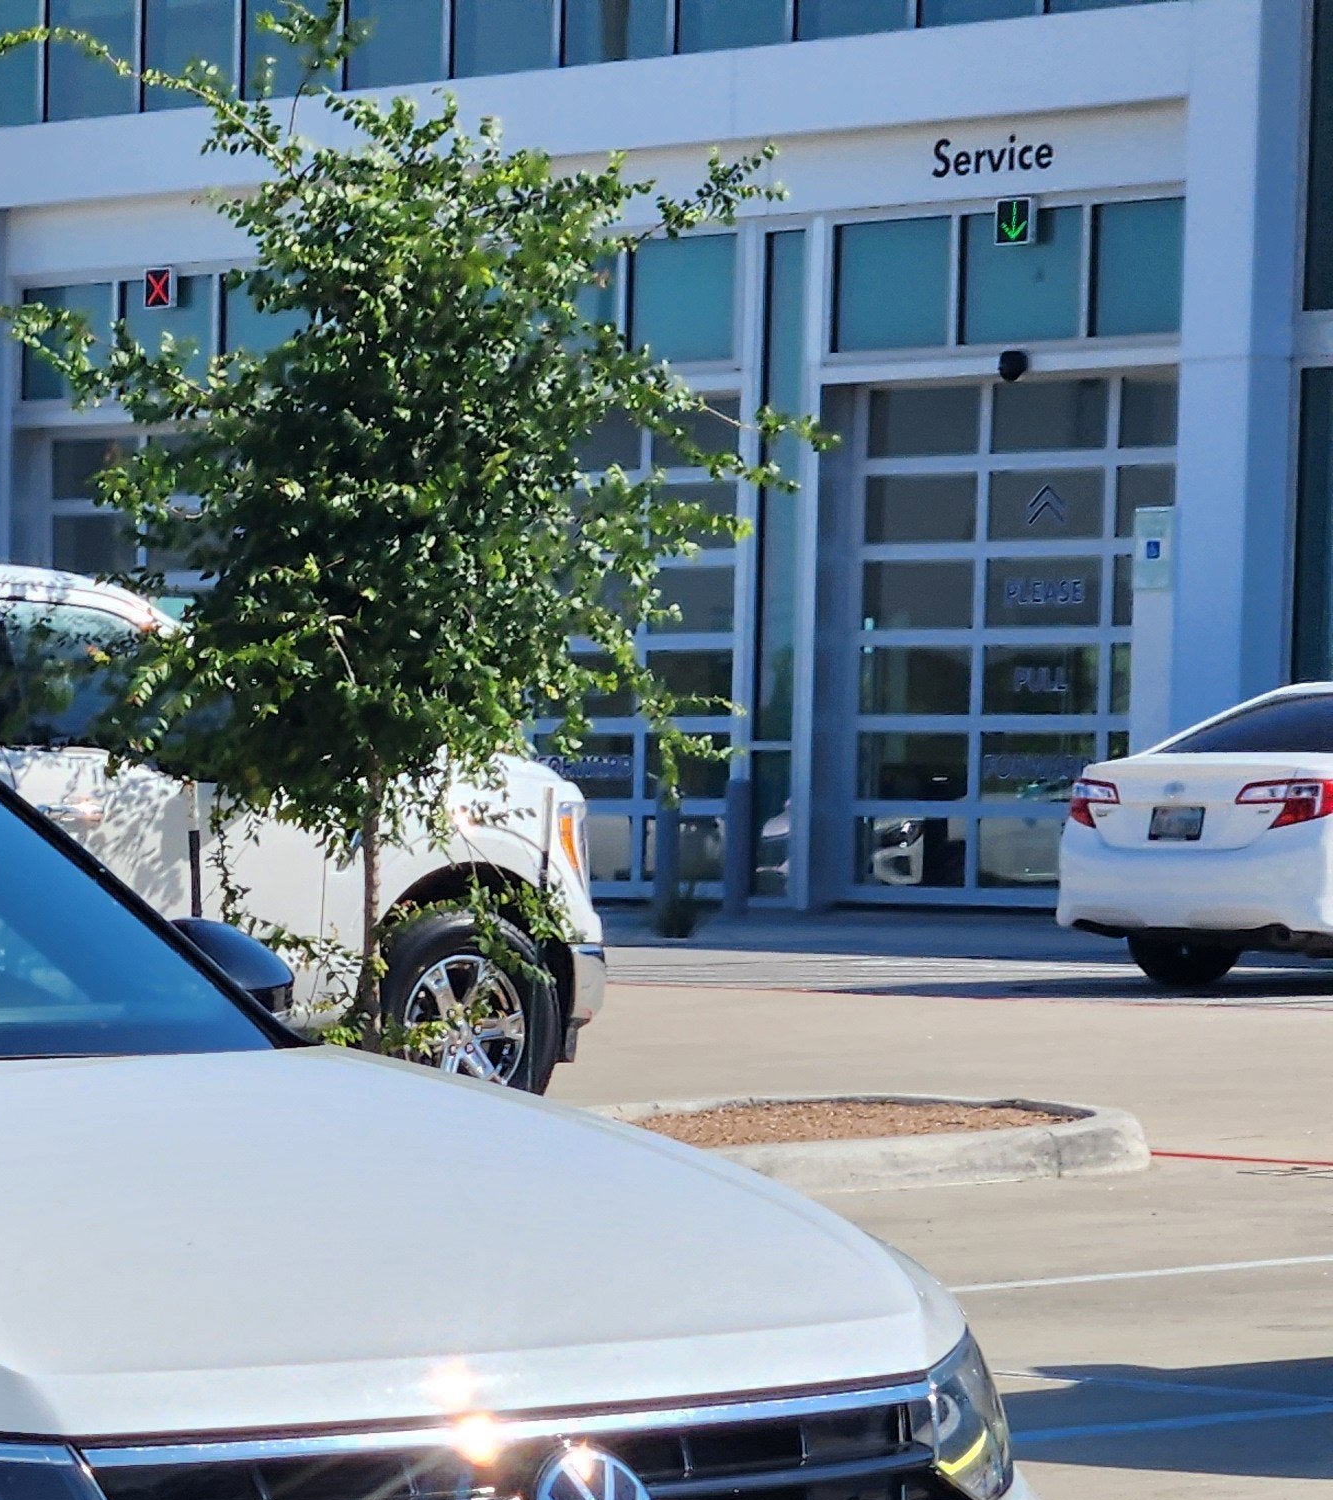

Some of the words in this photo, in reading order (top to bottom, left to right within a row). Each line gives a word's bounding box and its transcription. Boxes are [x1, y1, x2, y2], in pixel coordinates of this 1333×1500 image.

[932, 134, 1054, 178] Service
[1004, 578, 1084, 608] PLEASE
[1012, 666, 1068, 692] PULL
